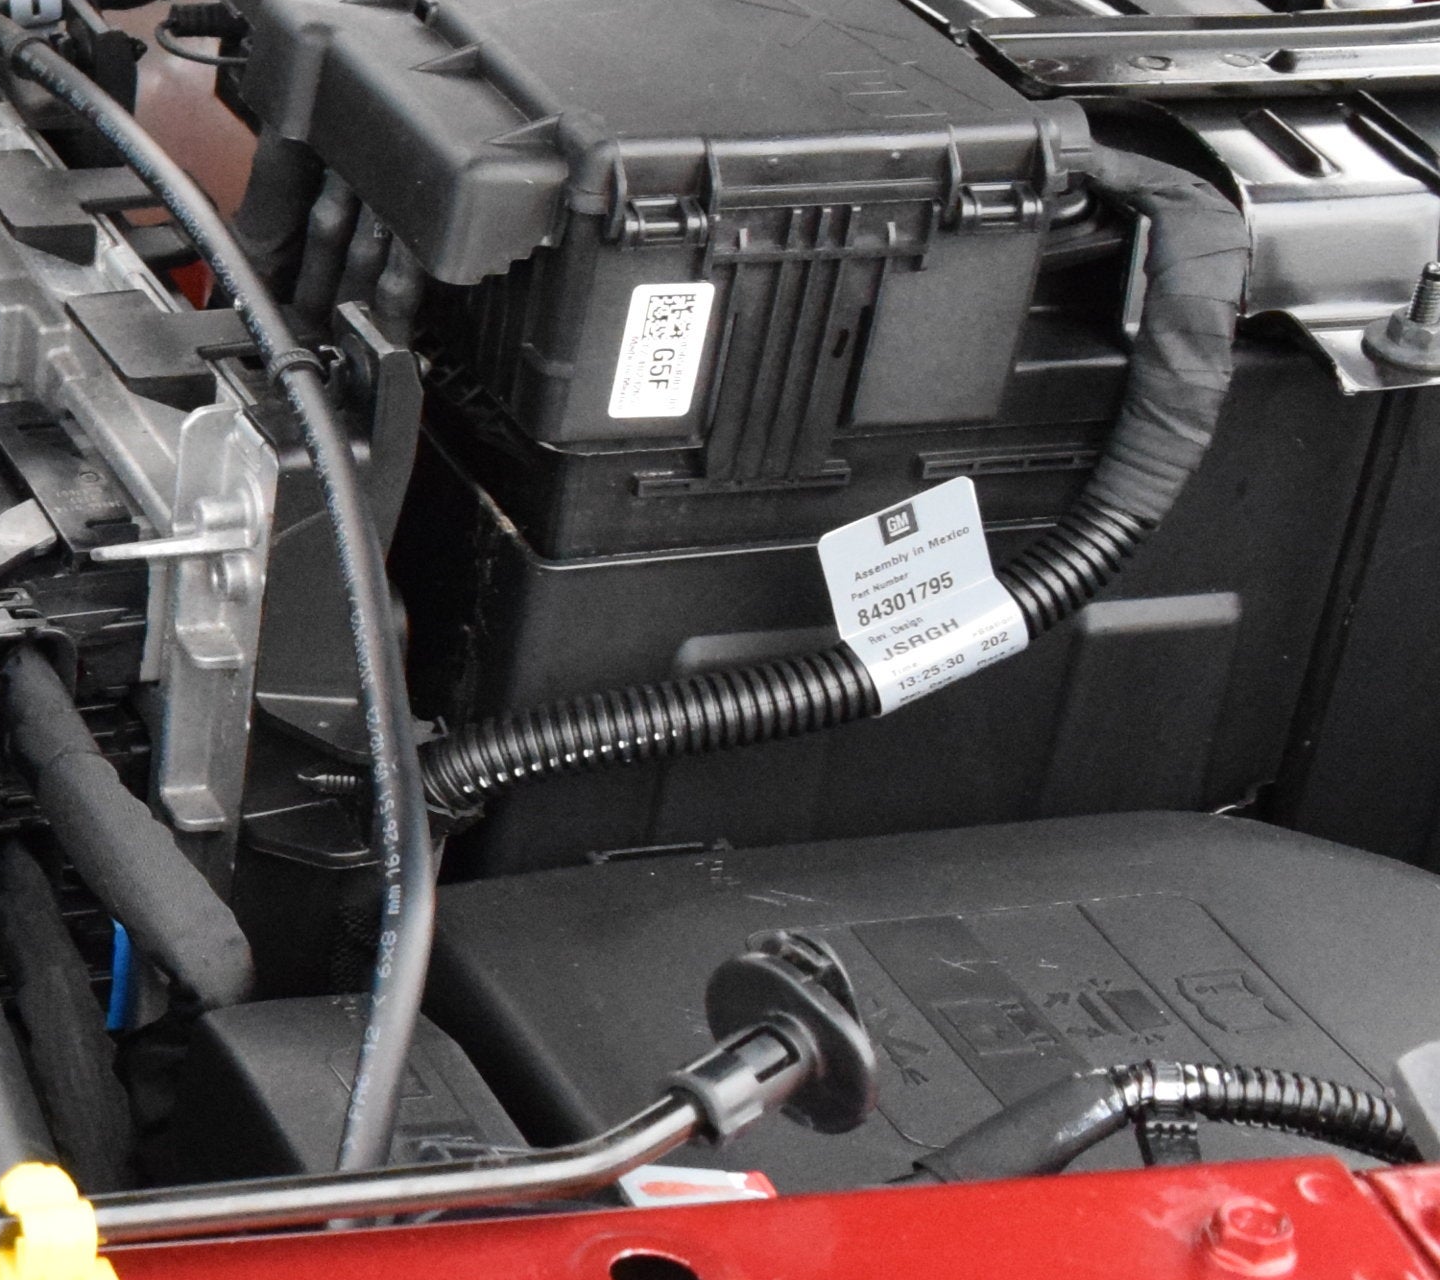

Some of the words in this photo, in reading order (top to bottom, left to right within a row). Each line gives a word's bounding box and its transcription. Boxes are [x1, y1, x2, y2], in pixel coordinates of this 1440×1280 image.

[648, 348, 675, 390] G5F
[885, 511, 910, 535] GM
[854, 550, 910, 582] Assembly
[913, 544, 925, 557] in
[928, 525, 970, 551] Mexico
[857, 571, 954, 628] 84301795
[882, 617, 960, 662] JSRGH
[981, 631, 1009, 652] 202
[898, 653, 965, 691] 13:25:30
